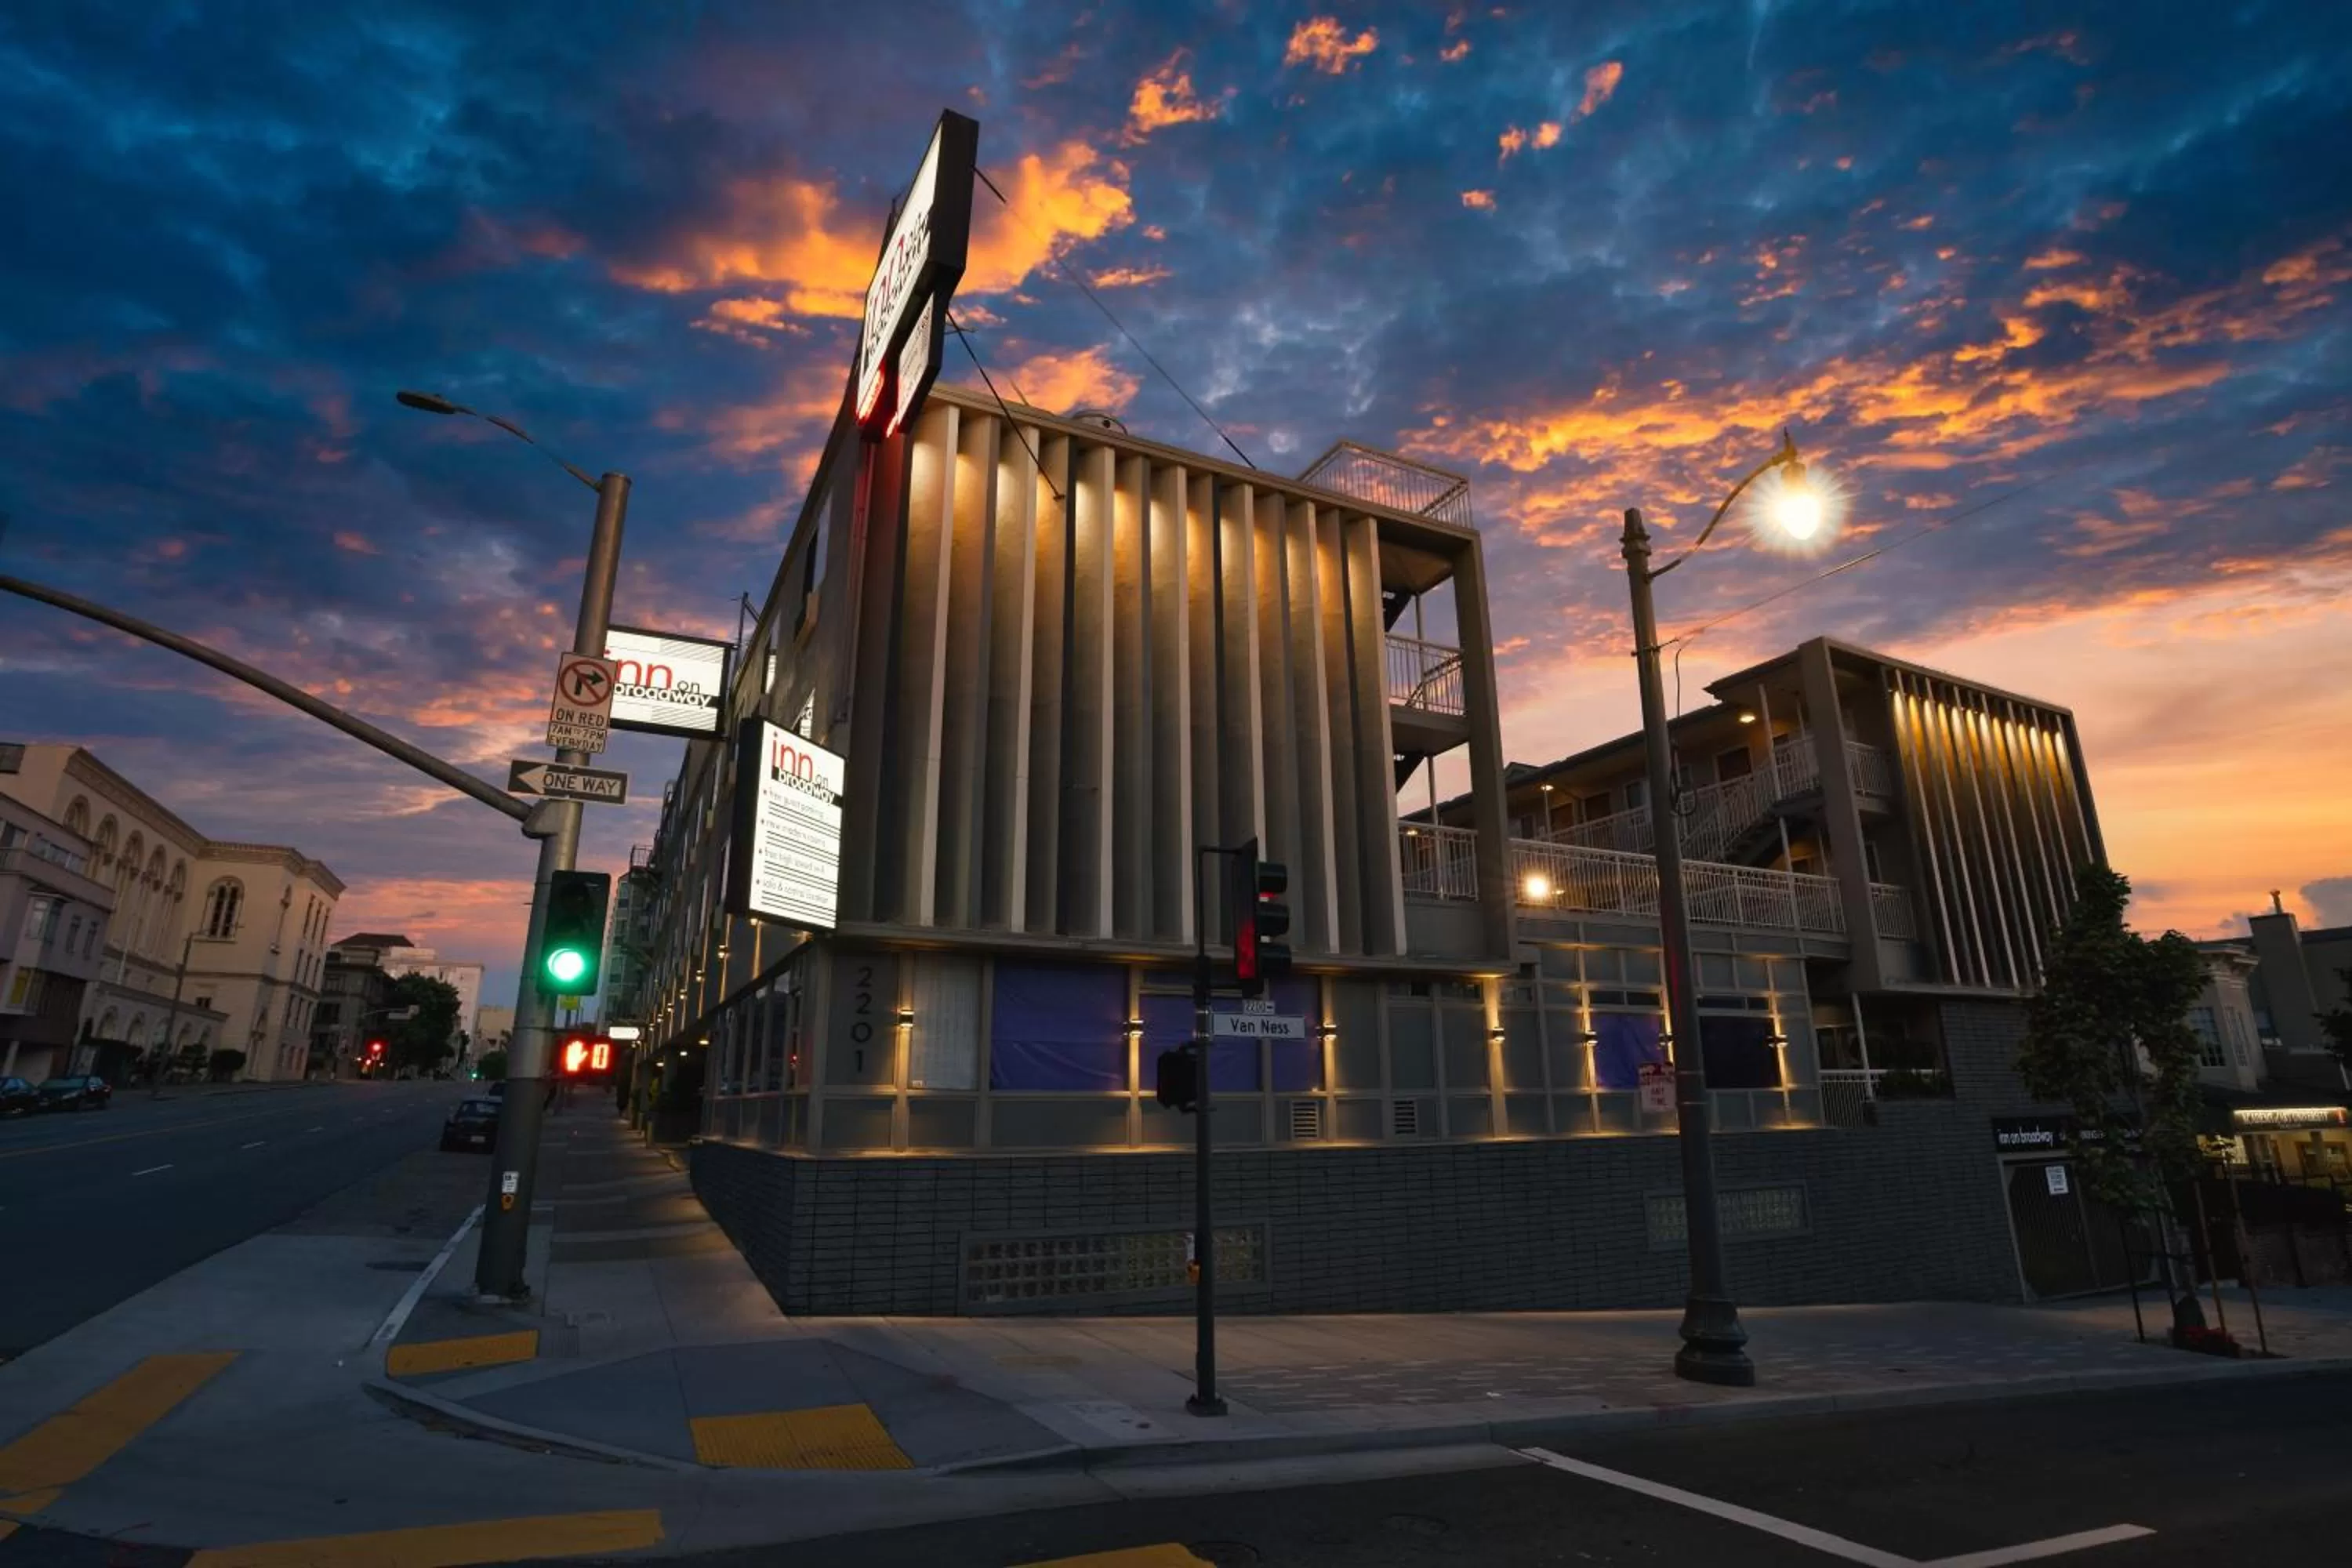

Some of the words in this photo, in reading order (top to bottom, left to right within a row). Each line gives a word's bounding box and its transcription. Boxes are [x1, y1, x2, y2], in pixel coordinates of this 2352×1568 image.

[604, 649, 673, 690] nn
[677, 681, 700, 694] on
[556, 708, 574, 722] ON
[578, 713, 604, 727] RED
[550, 735, 603, 752] EVERYDAY
[551, 724, 572, 736] 7AM
[583, 729, 604, 740] 7PM
[771, 731, 813, 782] inn
[815, 774, 829, 789] on
[543, 771, 577, 789] ONE
[583, 778, 618, 795] WAY
[778, 768, 835, 805] broadway
[850, 966, 873, 1073] 2201
[1230, 1017, 1255, 1033] Van
[1261, 1019, 1290, 1035] Ness
[592, 1044, 609, 1069] 10
